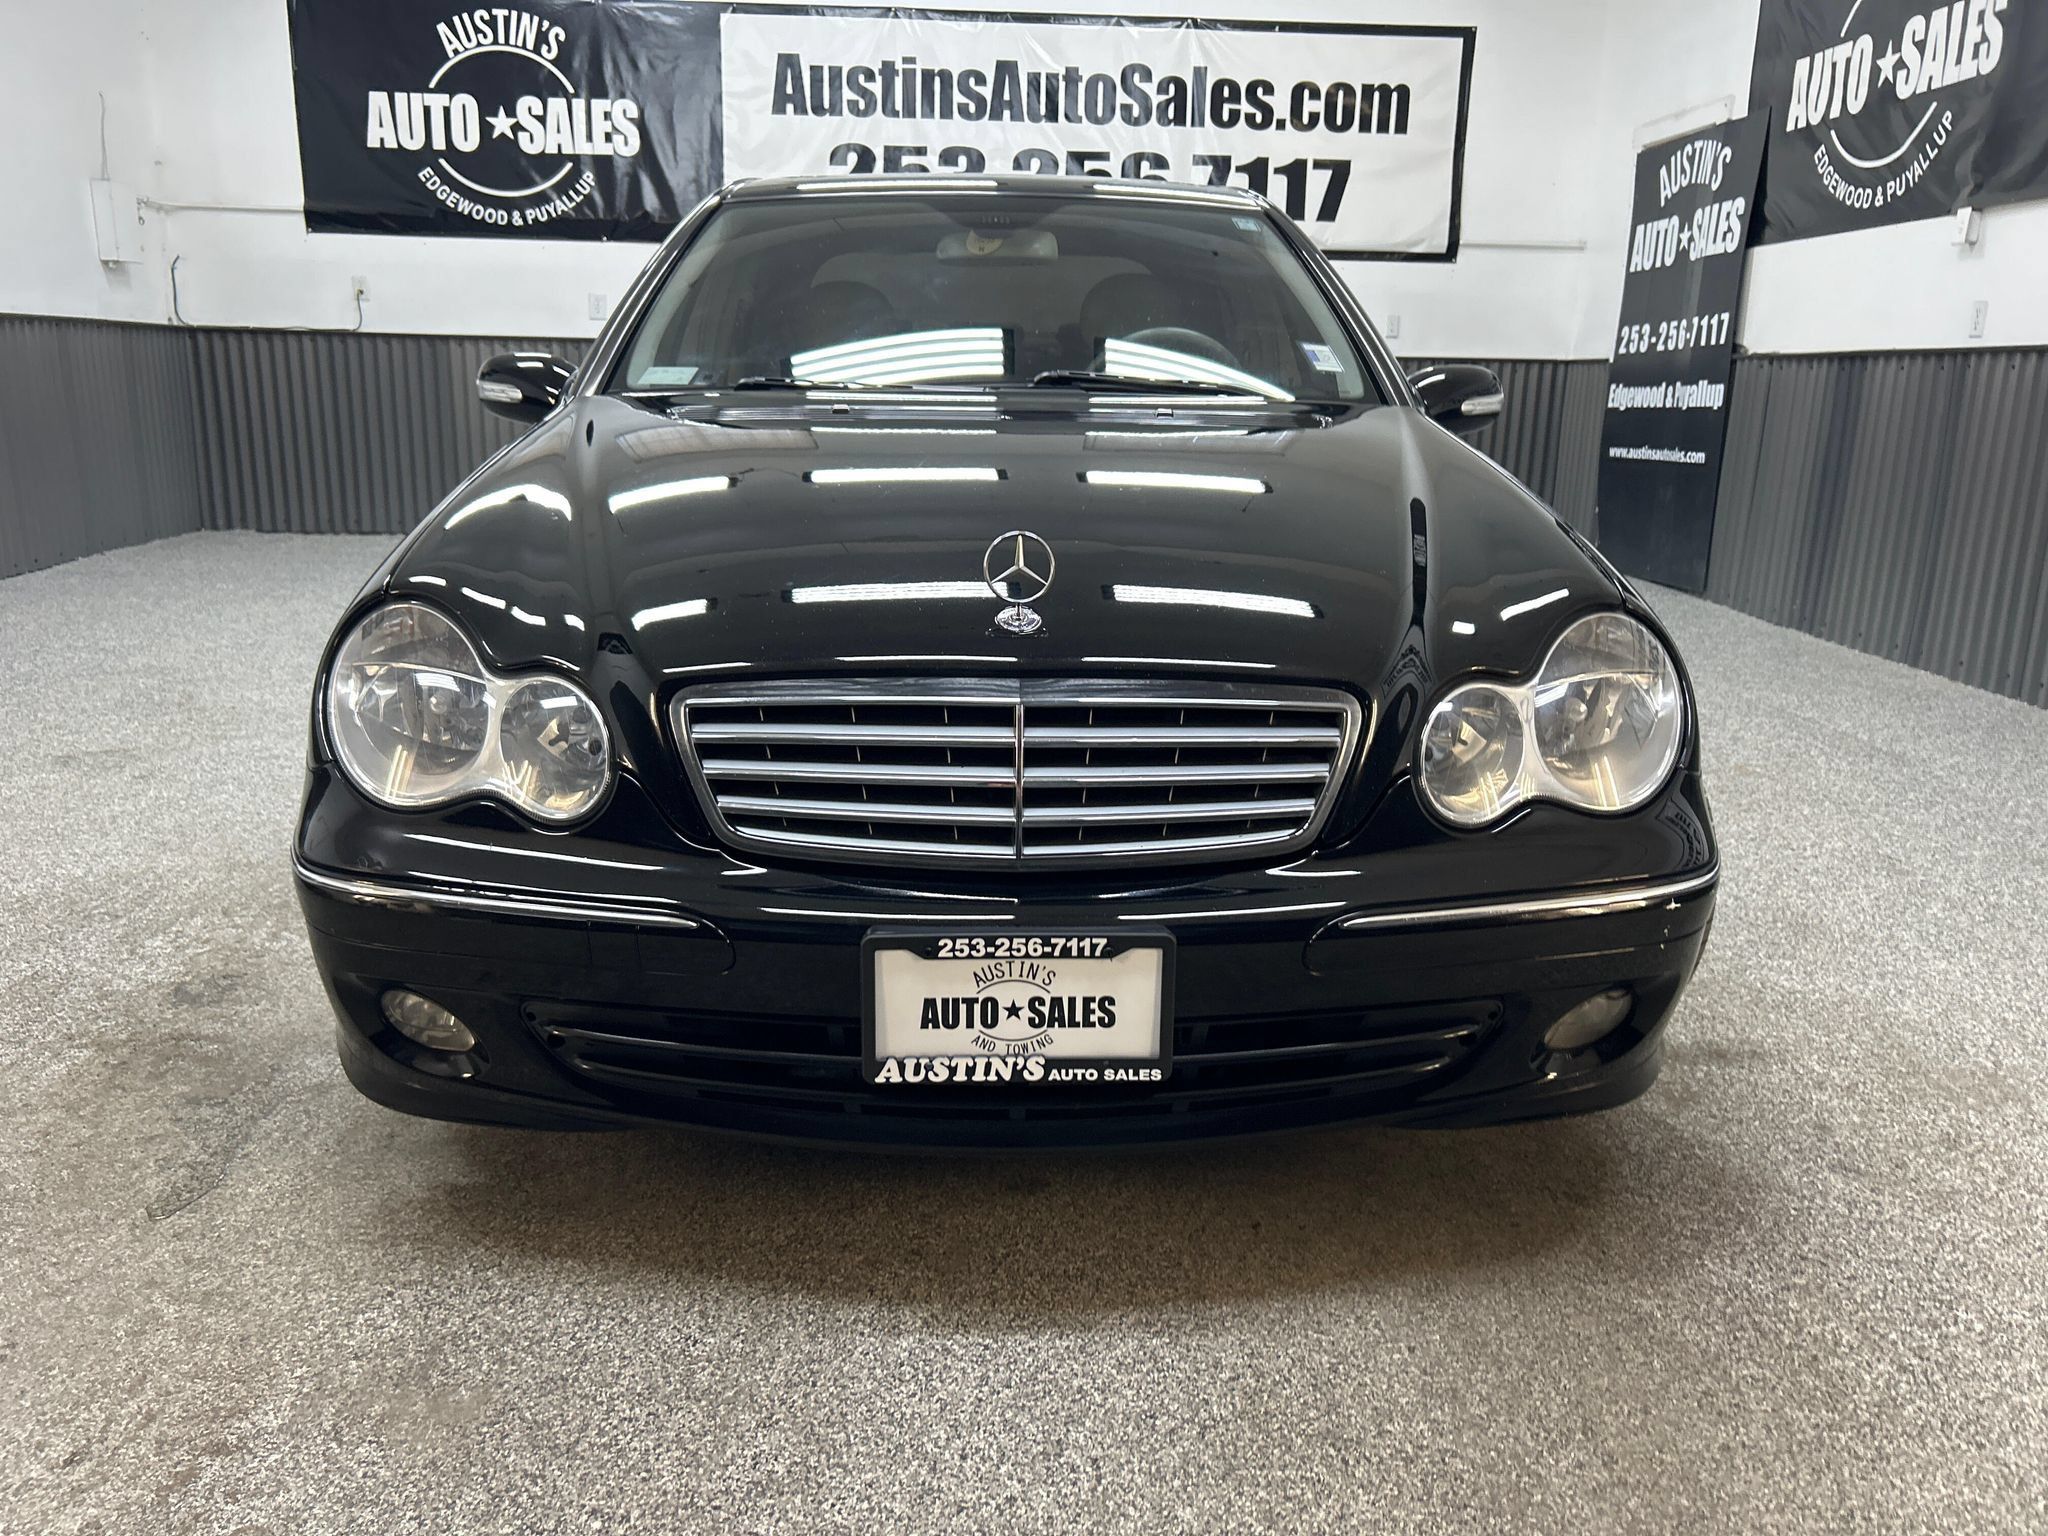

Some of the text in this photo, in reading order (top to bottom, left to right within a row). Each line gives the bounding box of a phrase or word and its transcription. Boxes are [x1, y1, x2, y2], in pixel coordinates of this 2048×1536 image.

[436, 8, 566, 60] AUSTIN'S
[1786, 0, 2008, 133] AUTO SALES
[771, 53, 1411, 135] AustinsAutoSales.com
[366, 90, 641, 157] AUTO SALES
[1660, 139, 1733, 208] AUSTIN'S
[1813, 110, 1953, 209] EDGEWOOD & PUYALLUP
[418, 166, 596, 226] EDGEWOOD & PUYALLUP
[1629, 196, 1746, 273] AUTO SALES
[1618, 312, 1730, 354] 253-256-7117
[1607, 382, 1666, 411] Edgewood
[1664, 385, 1673, 409] &
[938, 938, 1108, 958] 253-256-7117
[972, 960, 1057, 988] AUSTIN'S
[920, 995, 1116, 1029] AUTO SALES
[874, 1055, 1162, 1083] AUSTIN'S AUTO SALES
[971, 1034, 1054, 1056] AND TOWING
